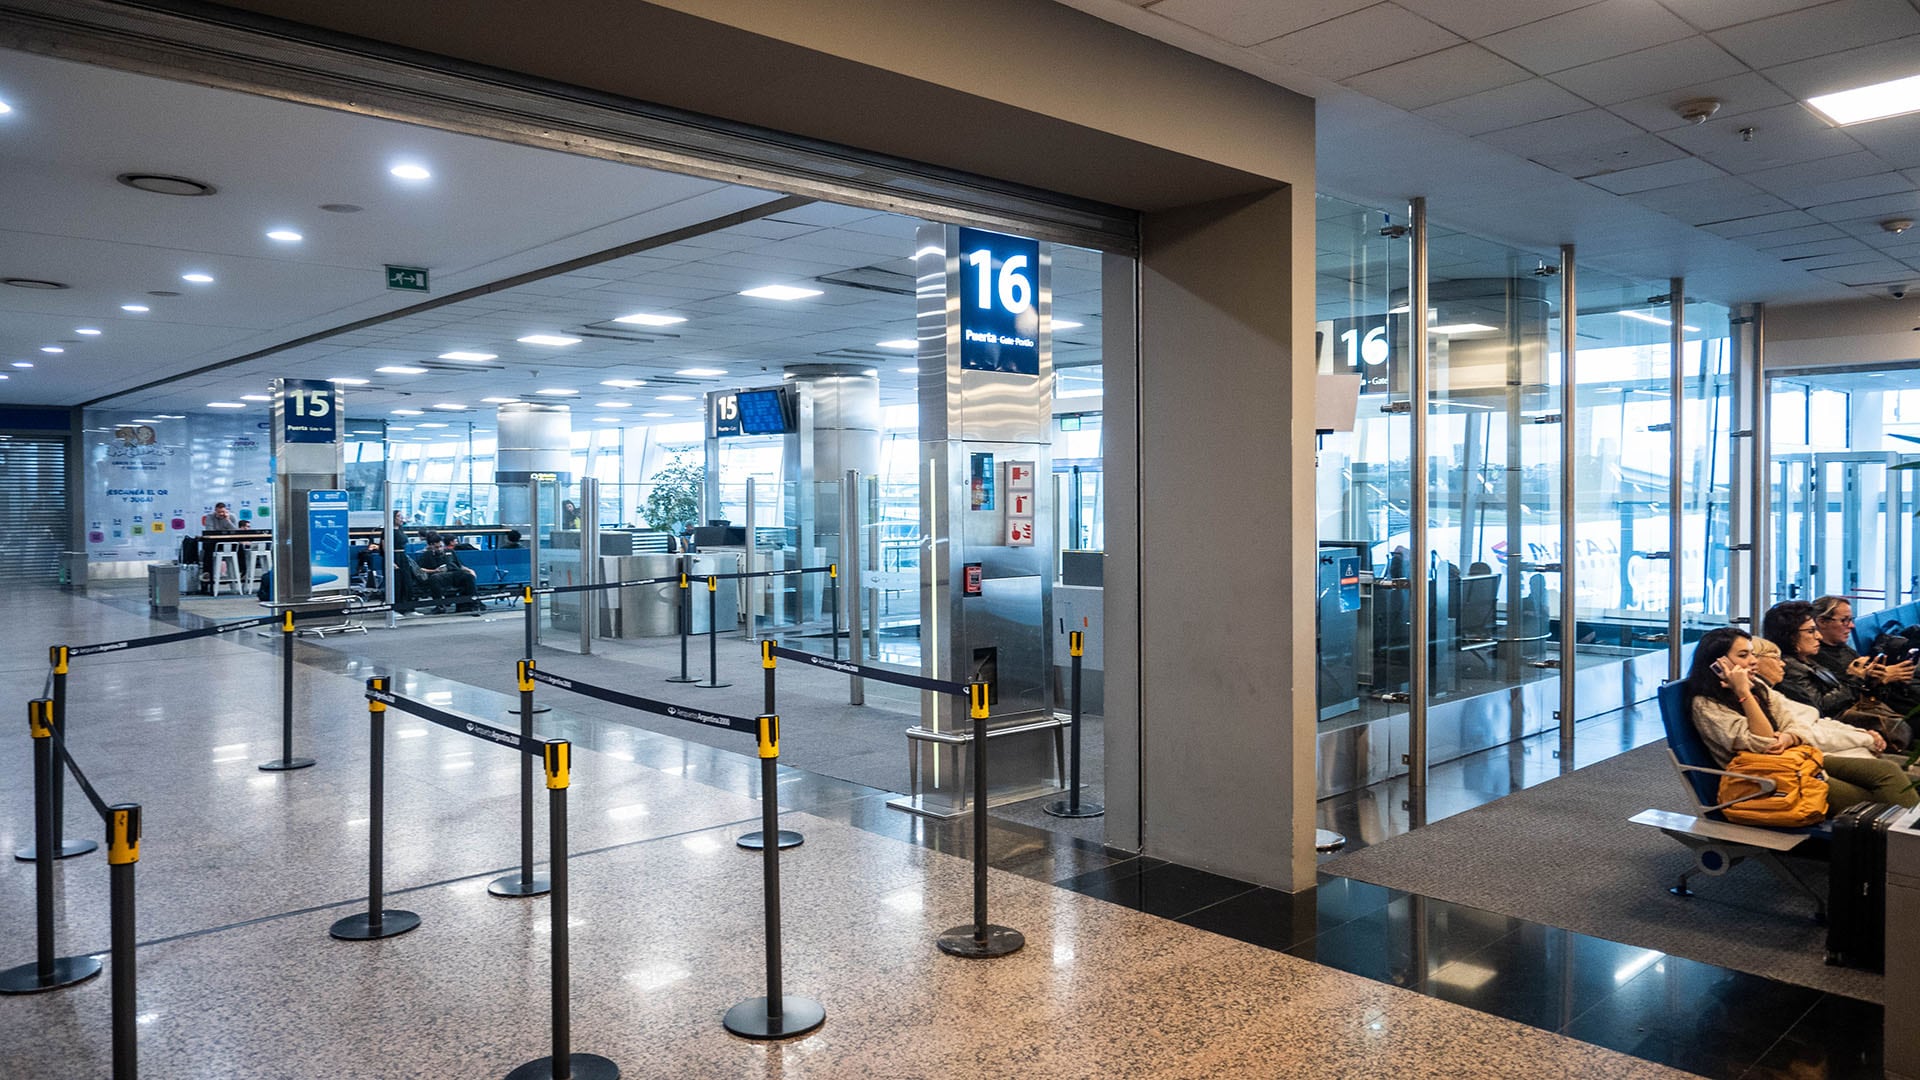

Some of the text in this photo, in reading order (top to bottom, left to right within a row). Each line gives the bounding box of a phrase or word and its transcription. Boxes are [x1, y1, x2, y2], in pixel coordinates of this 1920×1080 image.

[969, 249, 1031, 314] 16
[966, 329, 997, 343] Puerta
[1341, 326, 1389, 366] 16
[290, 390, 330, 417] 15
[718, 396, 737, 420] 15
